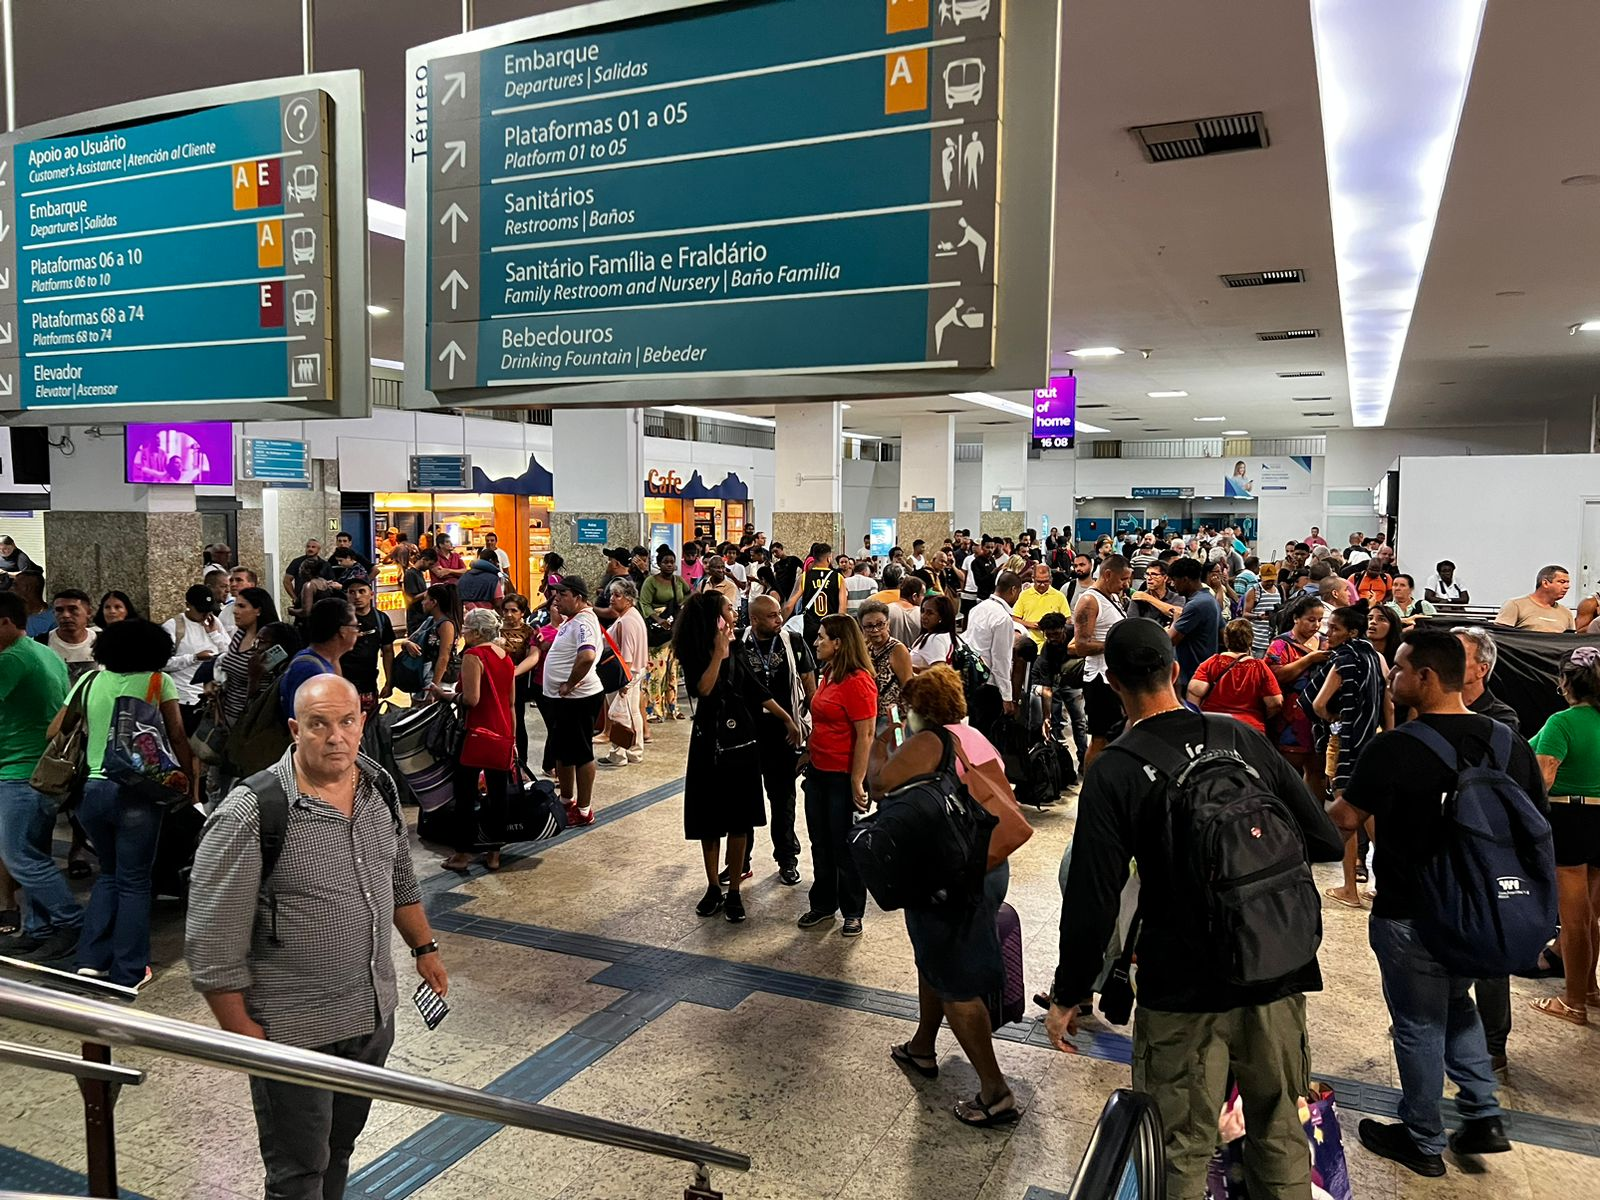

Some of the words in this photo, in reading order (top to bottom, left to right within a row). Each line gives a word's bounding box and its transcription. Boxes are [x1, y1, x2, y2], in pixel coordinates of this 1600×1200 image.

[504, 43, 599, 75] Embarque
[890, 56, 912, 86] A
[505, 72, 583, 98] Departures
[594, 61, 648, 83] Salidas
[410, 64, 428, 163] Térreo
[505, 118, 613, 147] Plataformas
[618, 109, 638, 131] 01
[647, 111, 658, 127] a
[664, 102, 687, 125] 05
[28, 146, 62, 166] Apoio
[64, 146, 79, 160] ao
[81, 134, 126, 156] Usuário
[29, 164, 75, 183] Customer's
[76, 158, 122, 175] Assistance
[127, 148, 169, 167] Atención
[170, 145, 181, 160] al
[182, 142, 216, 158] Cliente
[505, 149, 565, 170] Platform
[569, 144, 585, 161] 01
[590, 144, 605, 158] to
[608, 138, 627, 156] 05
[236, 167, 249, 189] A
[258, 163, 269, 186] E
[30, 200, 87, 221] Embarque
[505, 187, 594, 213] Sanitários
[30, 221, 79, 238] Departures
[84, 214, 117, 230] Salidas
[505, 214, 579, 235] Restrooms
[589, 209, 635, 227] Baños
[260, 224, 274, 247] A
[31, 256, 97, 275] Plataformas
[99, 251, 115, 268] 06
[116, 254, 124, 266] a
[127, 248, 142, 265] 10
[506, 257, 584, 282] Sanitário
[590, 250, 655, 275] Família
[661, 254, 673, 269] e
[679, 241, 767, 268] Fraldário
[31, 278, 73, 292] Platforms
[74, 275, 86, 288] 06
[87, 276, 97, 287] to
[100, 273, 111, 286] 10
[505, 285, 551, 305] Family
[554, 283, 623, 300] Restroom
[626, 276, 657, 295] and
[659, 275, 720, 293] Nursery
[731, 268, 773, 287] Baño
[777, 262, 840, 283] Familia
[261, 285, 272, 307] E
[32, 310, 99, 329] Plataformas
[100, 307, 116, 324] 68
[118, 310, 126, 322] a
[128, 305, 144, 321] 74
[33, 332, 75, 346] Platforms
[76, 330, 88, 343] 68
[89, 331, 99, 342] to
[100, 328, 112, 341] 74
[502, 325, 613, 348] Bebedouros
[501, 352, 562, 371] Drinking
[565, 349, 632, 366] Fountain
[643, 344, 707, 363] Bebeder
[34, 363, 83, 381] Elevador
[36, 385, 72, 398] Elevator
[76, 384, 118, 396] Ascensor
[1036, 387, 1057, 399] out
[1036, 401, 1050, 413] of
[1036, 416, 1071, 427] home
[815, 591, 827, 616] 0
